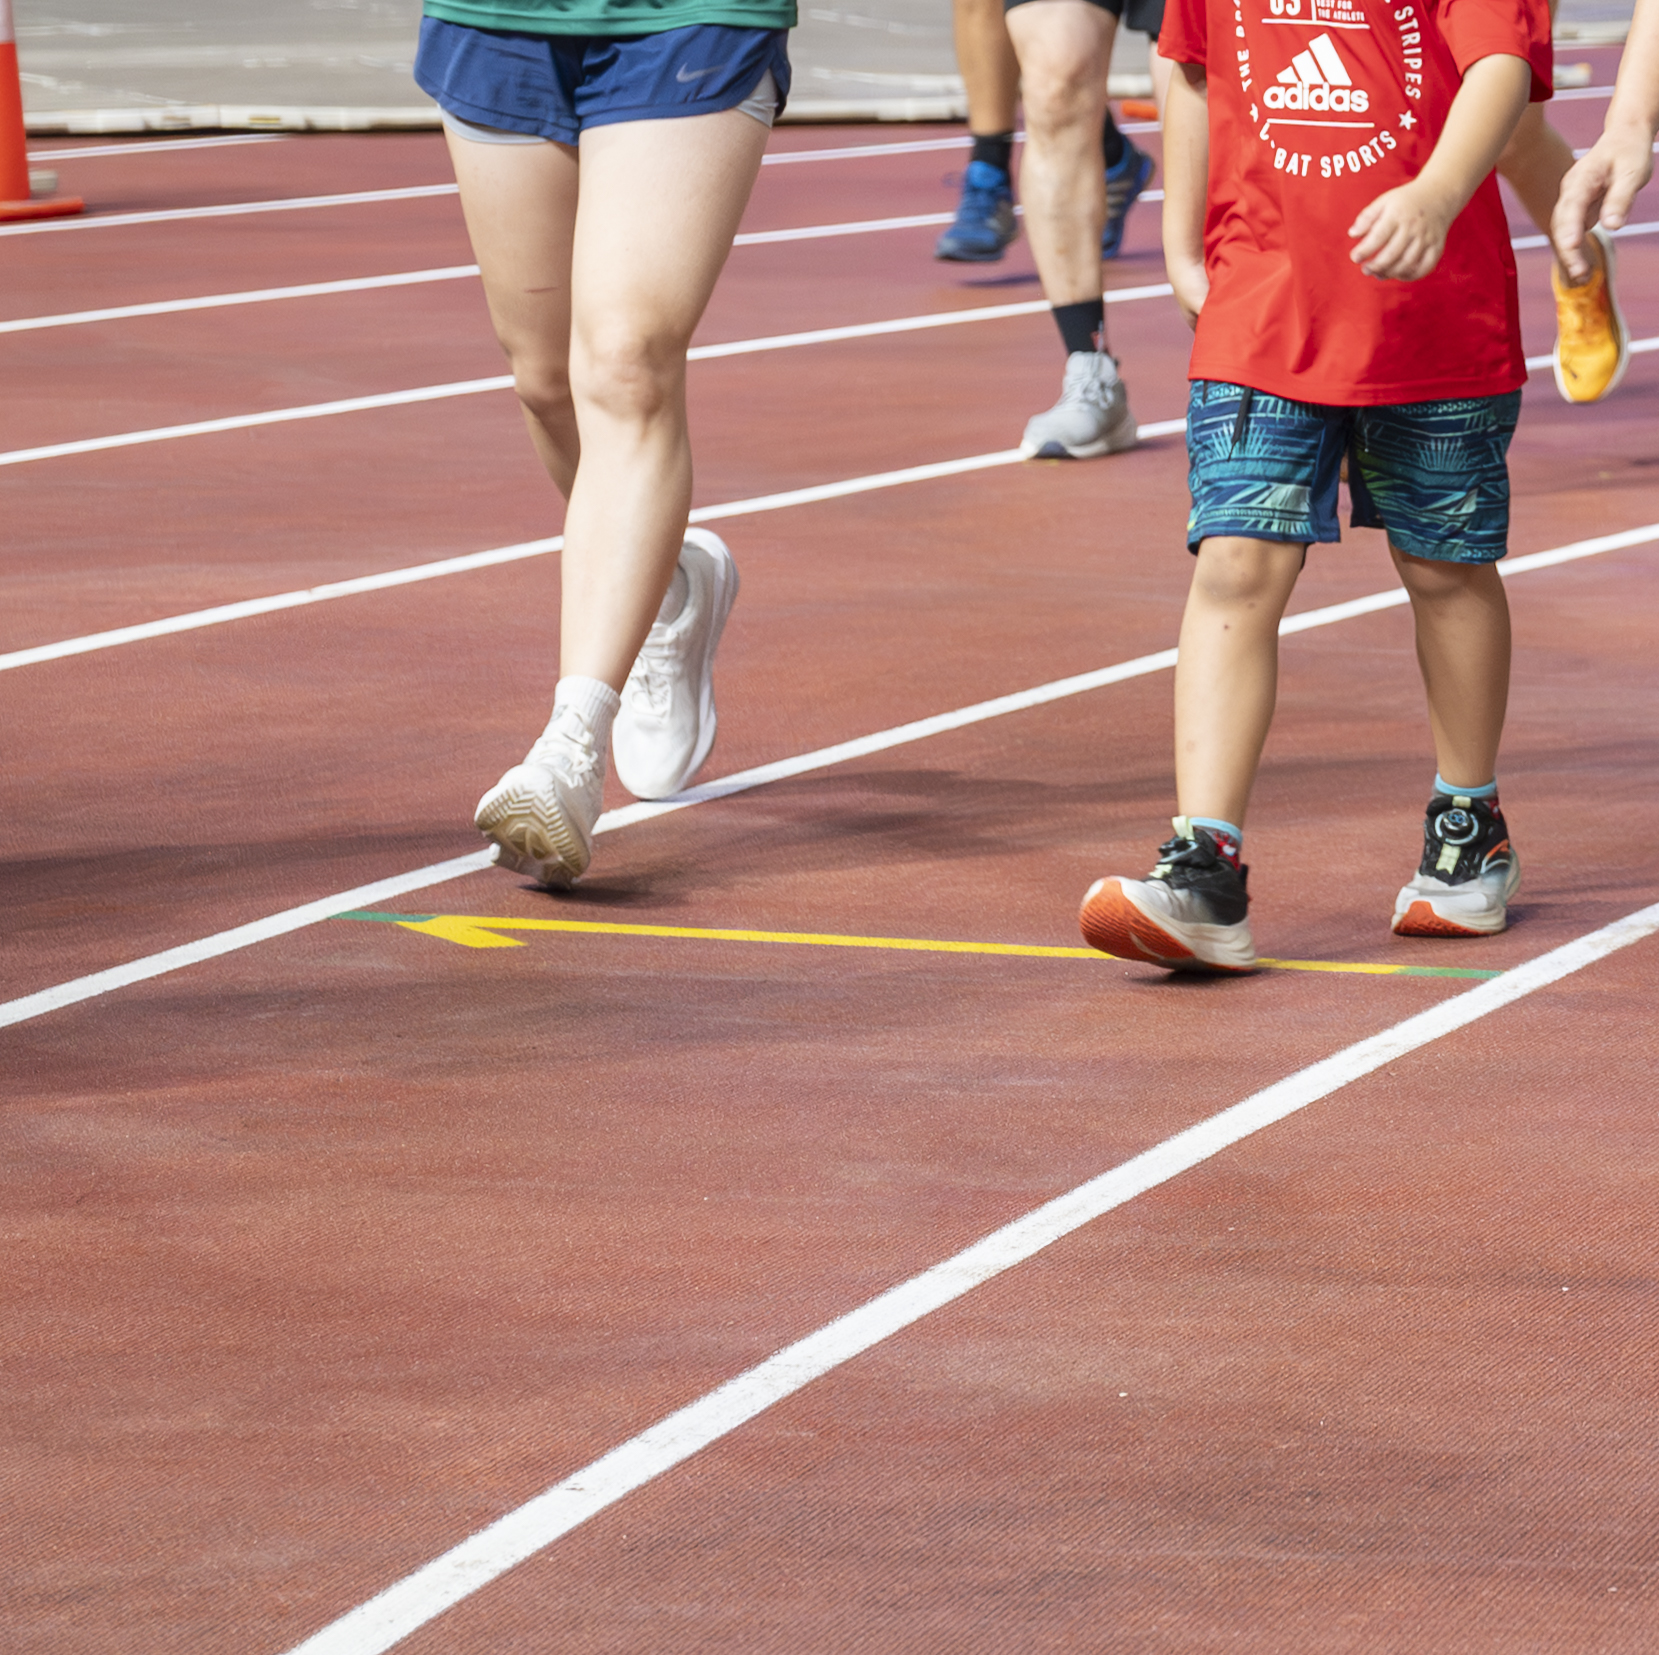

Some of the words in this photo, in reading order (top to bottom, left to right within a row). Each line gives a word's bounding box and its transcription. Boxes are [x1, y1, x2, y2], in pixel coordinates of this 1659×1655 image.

[1236, 48, 1252, 92] THE
[1394, 5, 1422, 100] STRIPES
[1263, 80, 1370, 113] adidas
[1320, 130, 1397, 178] SPORTS
